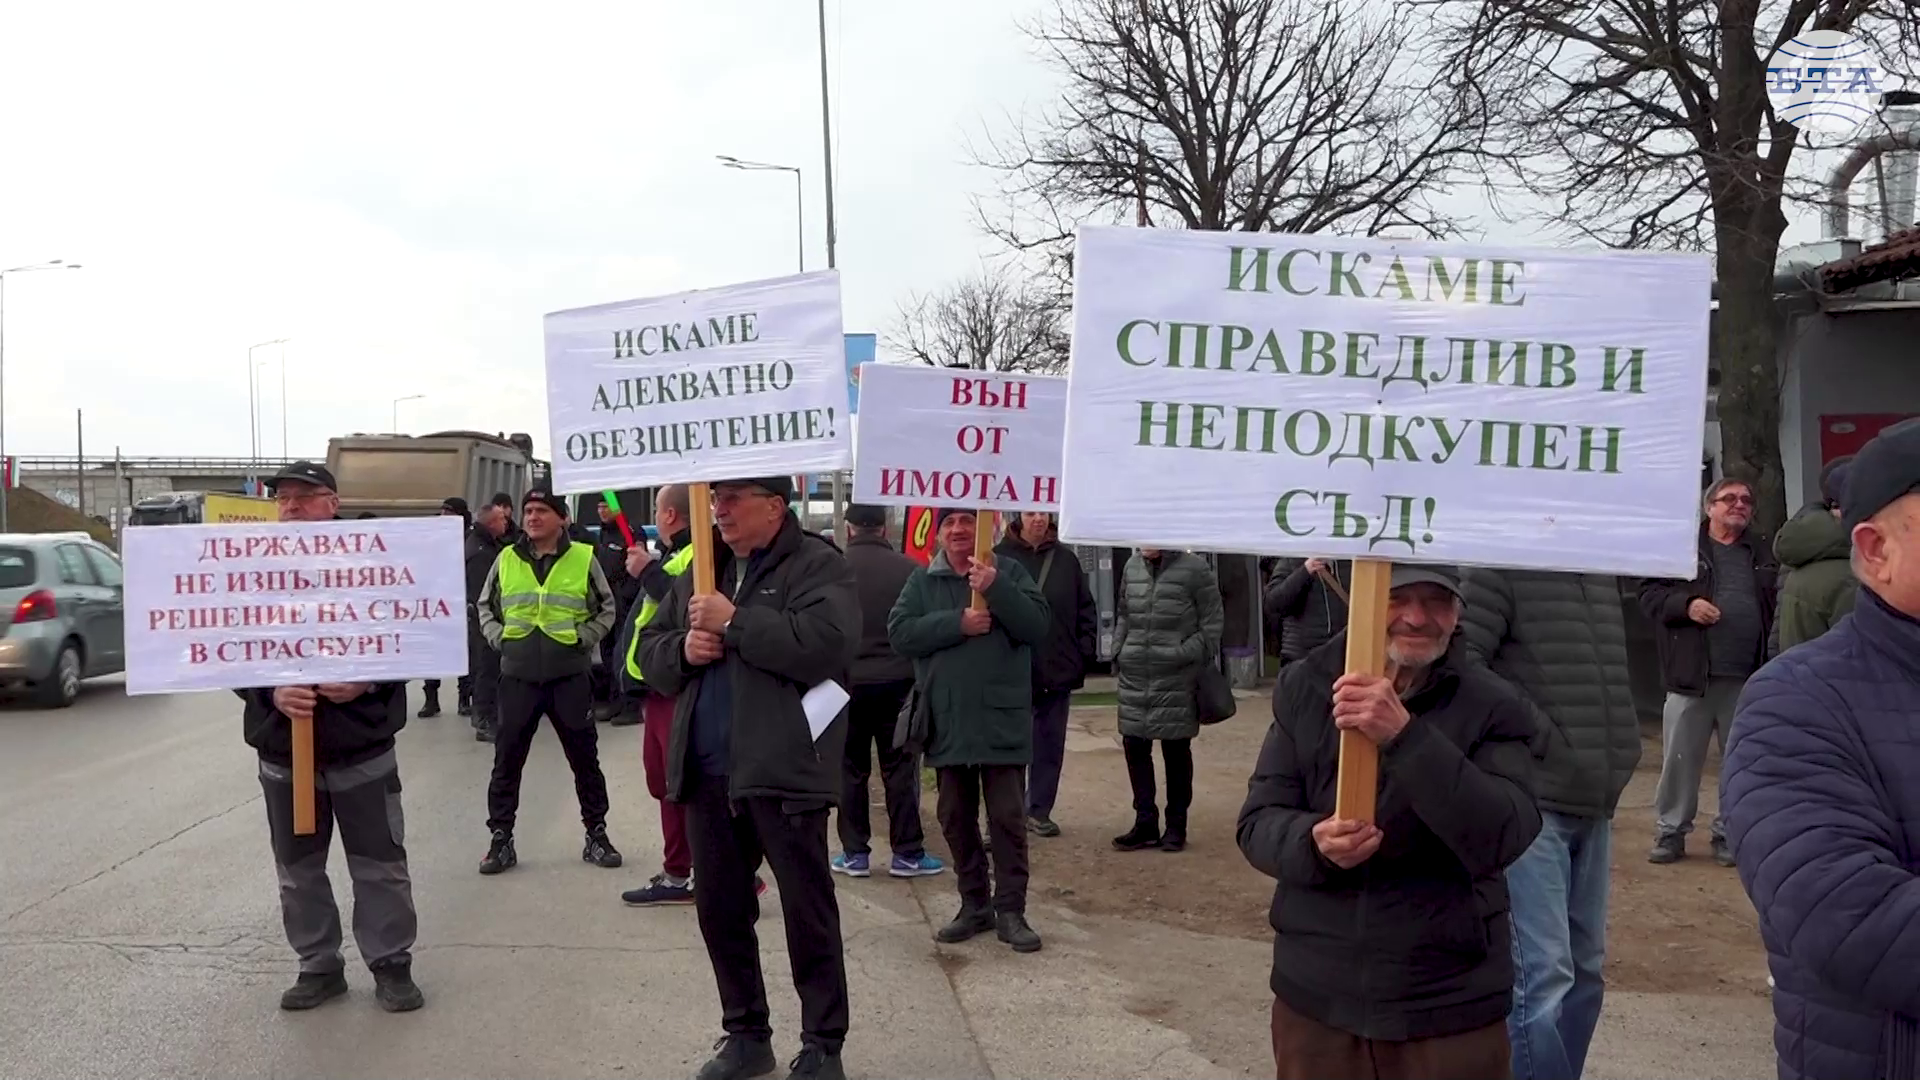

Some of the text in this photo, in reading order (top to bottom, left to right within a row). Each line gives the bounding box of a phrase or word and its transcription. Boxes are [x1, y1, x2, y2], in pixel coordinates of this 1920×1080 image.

[1225, 245, 1527, 307] ИСКАМЕ
[613, 312, 760, 360] ИСКАМЕ
[1116, 318, 1648, 394] СПРАВЕДЛИВ И
[591, 359, 795, 416] АДЕКВАТНО
[950, 376, 1029, 410] ВЪН
[565, 406, 836, 463] ОБЕЗЩЕТЕНИЕ!
[956, 424, 1010, 455] ОТ
[1135, 399, 1625, 474] НЕПОДКУПЕН
[878, 467, 1062, 504] ИМОТА Н
[1274, 488, 1437, 553] СЪД!
[198, 532, 388, 563] ДЪРЖАВАТА
[174, 565, 416, 595] НЕ ИЗПЪЛНЯВА
[148, 597, 451, 631] РЕШЕНИЕ НА СЪДА
[189, 633, 402, 665] В СТРАСБУРГ!
